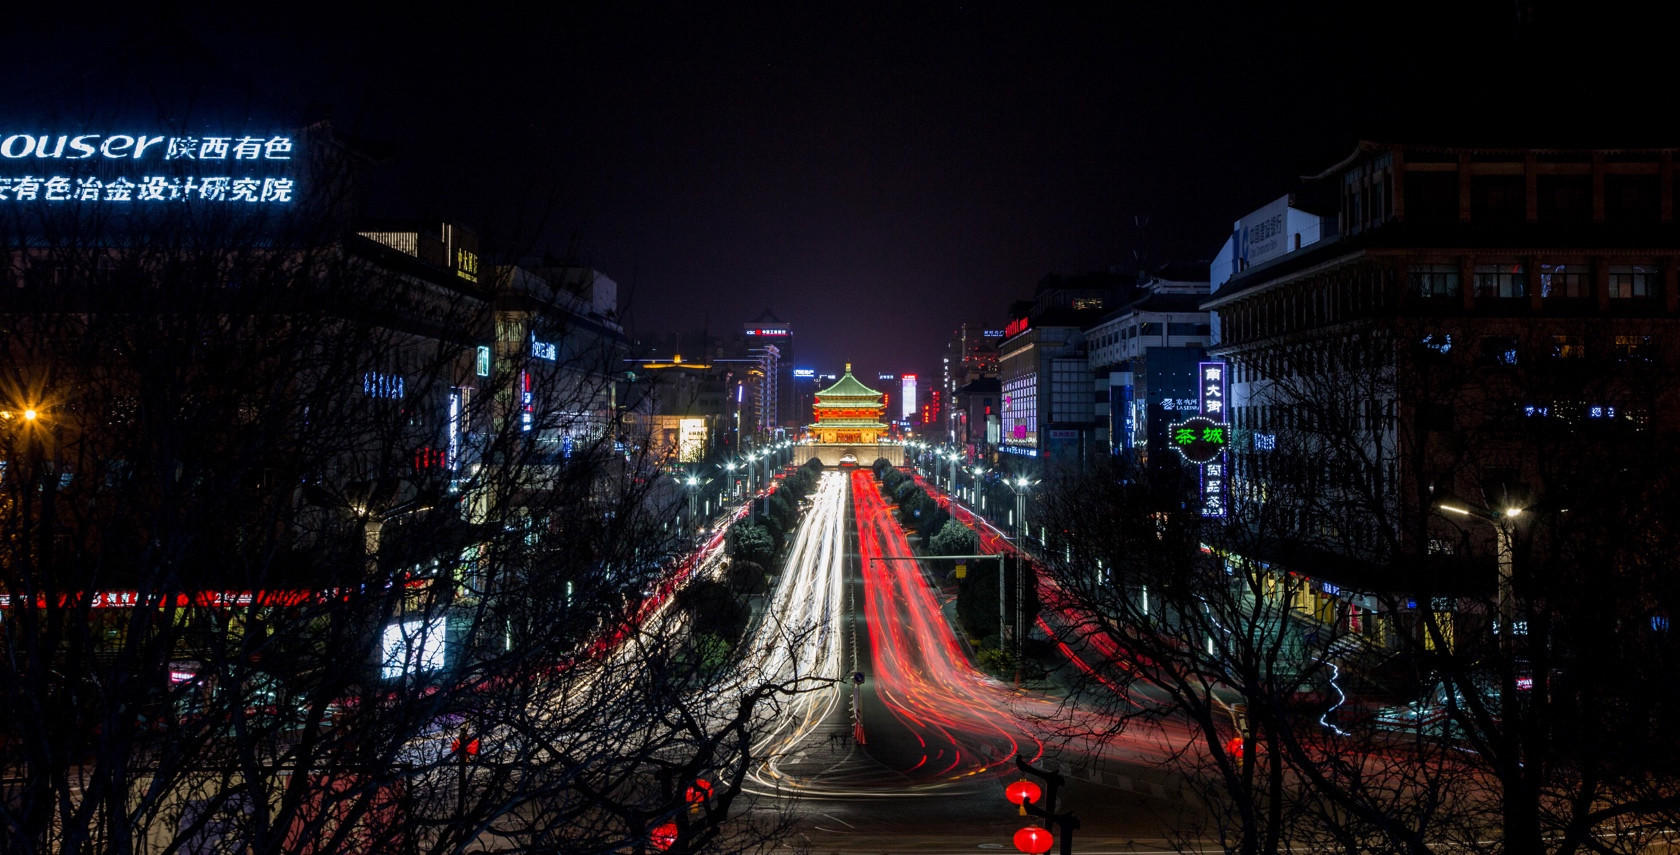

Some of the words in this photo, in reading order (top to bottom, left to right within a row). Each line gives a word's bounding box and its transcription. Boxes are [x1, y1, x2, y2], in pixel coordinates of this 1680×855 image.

[0, 133, 165, 160] ouser
[166, 135, 293, 160] 陕西有色
[1205, 367, 1223, 413] 南大街
[1174, 426, 1225, 445] 茶城
